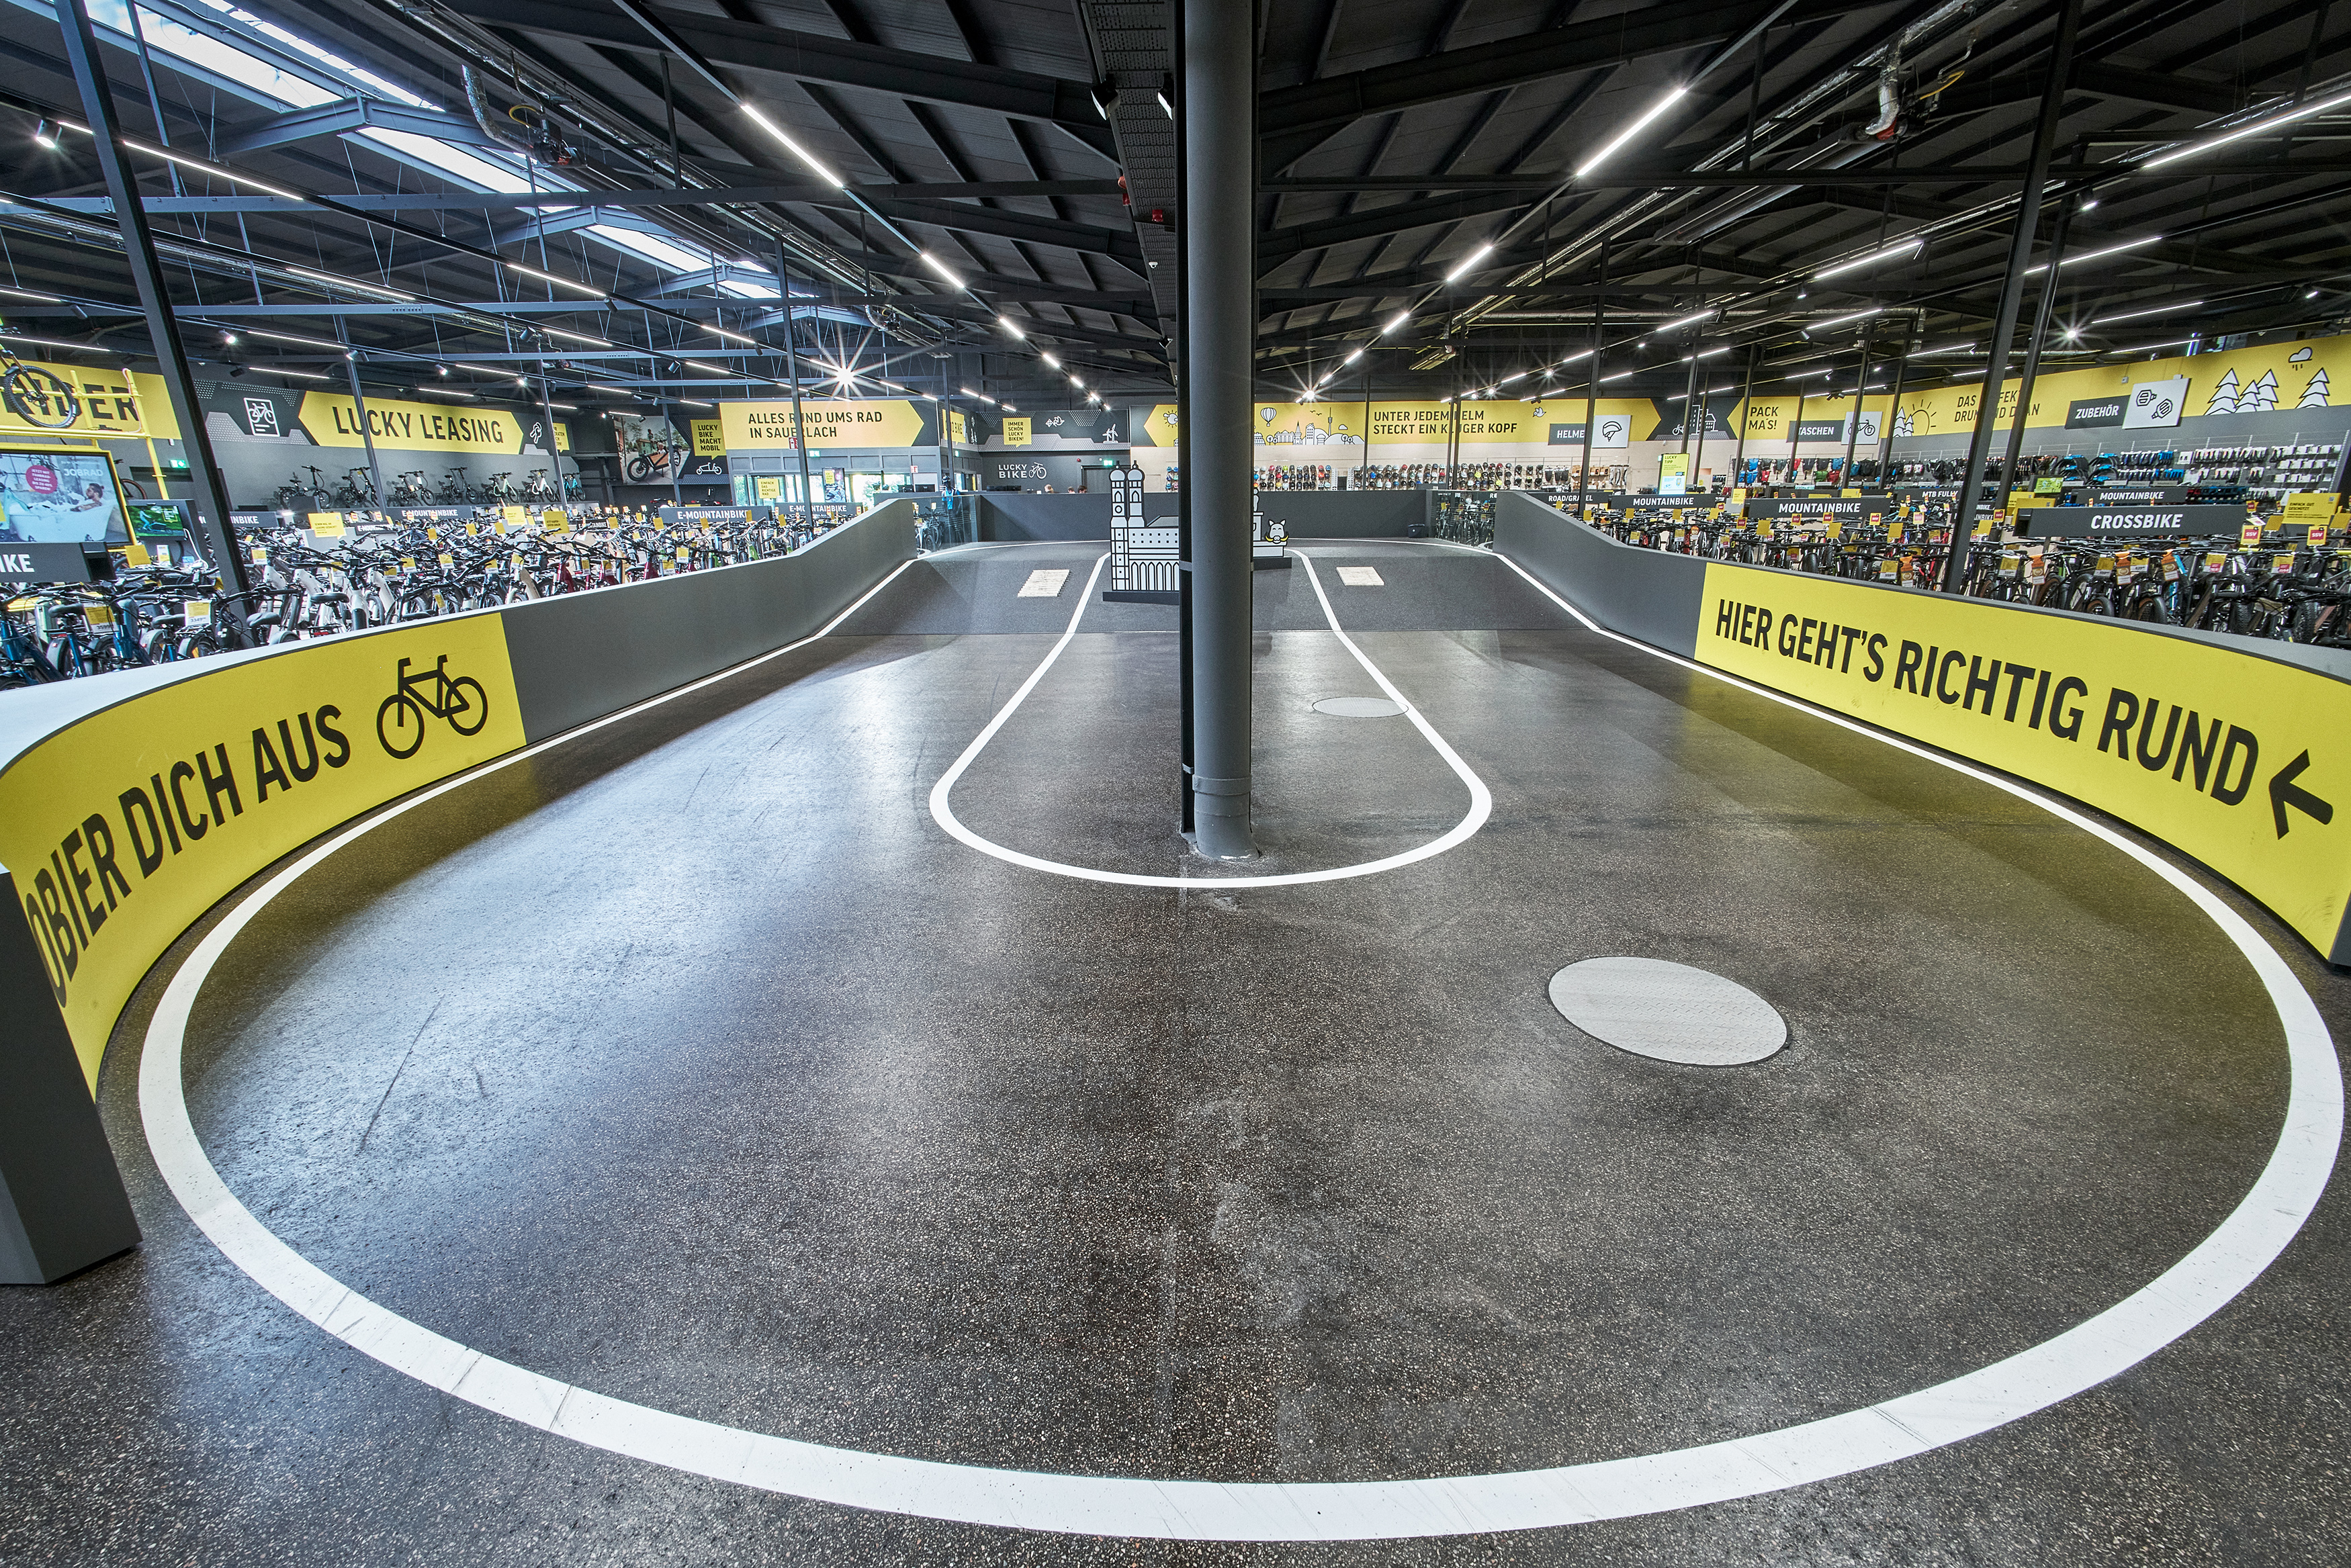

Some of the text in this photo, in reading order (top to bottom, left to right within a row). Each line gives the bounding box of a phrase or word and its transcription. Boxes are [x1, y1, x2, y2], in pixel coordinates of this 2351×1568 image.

[1957, 395, 1976, 408] DAS
[1374, 410, 1411, 422] UNTER
[1414, 410, 1449, 421] JEDEM
[1750, 406, 1779, 417] PACK
[2009, 404, 2040, 418] DN
[2075, 405, 2119, 419] ZUBEHÖR
[748, 412, 785, 424] ALLES
[826, 412, 852, 423] UMS
[857, 412, 883, 422] RAD
[332, 406, 504, 443] LUCKY LEASING
[1374, 423, 1517, 434] STECKT EIN KGER KOPF
[1798, 426, 1834, 435] TASCHEN
[750, 426, 837, 438] IN SAUELACH
[1556, 429, 1585, 439] HELME
[1633, 497, 1694, 506] MOUNTAINBIKE
[2099, 491, 2165, 500] MOUNTAINBIKE
[1779, 503, 1861, 513] MOUNTAINBIKE
[2090, 514, 2184, 529] CROSSBIKE
[0, 554, 35, 573] IKE
[1716, 598, 2260, 806] HIER GEHT'S RICHTIG RUND
[118, 742, 244, 880] DICH
[251, 704, 351, 804] AUS
